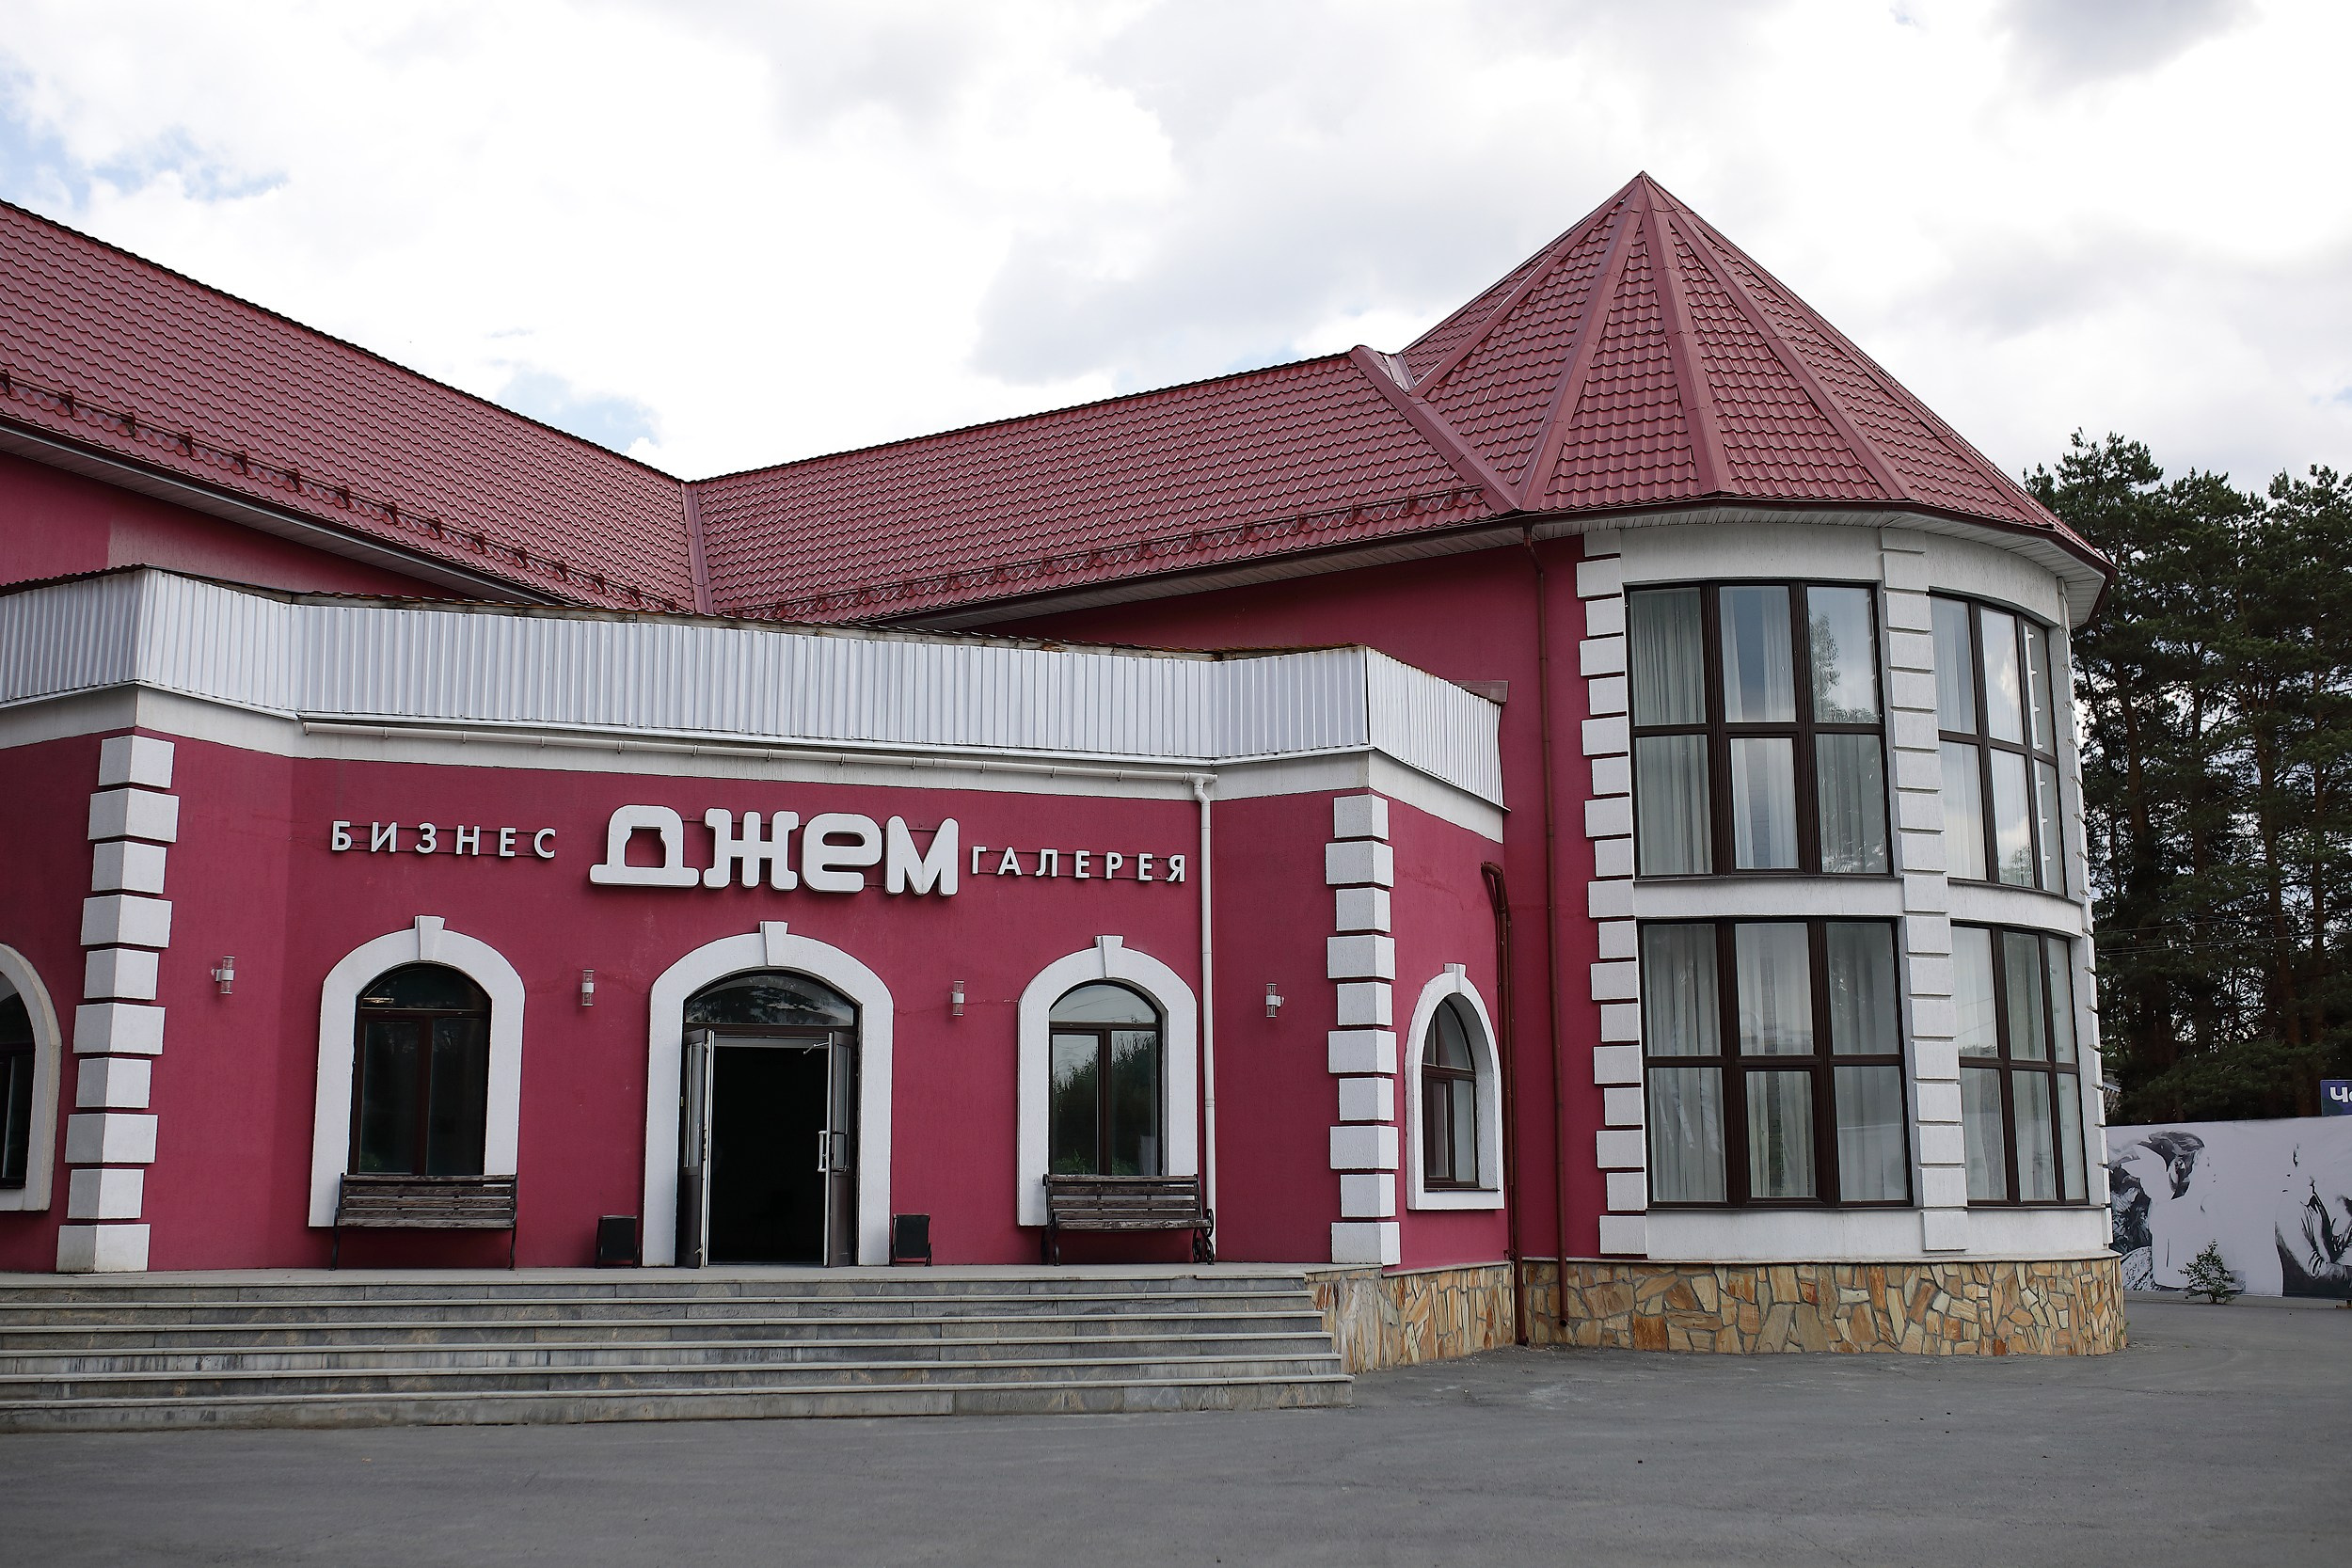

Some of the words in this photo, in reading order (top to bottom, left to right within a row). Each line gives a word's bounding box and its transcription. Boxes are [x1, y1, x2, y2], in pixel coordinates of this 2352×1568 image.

[330, 819, 557, 860] БИЗНЕС
[970, 845, 1186, 882] ГАЛЕРЕЯ
[2329, 1086, 2352, 1102] Ч
